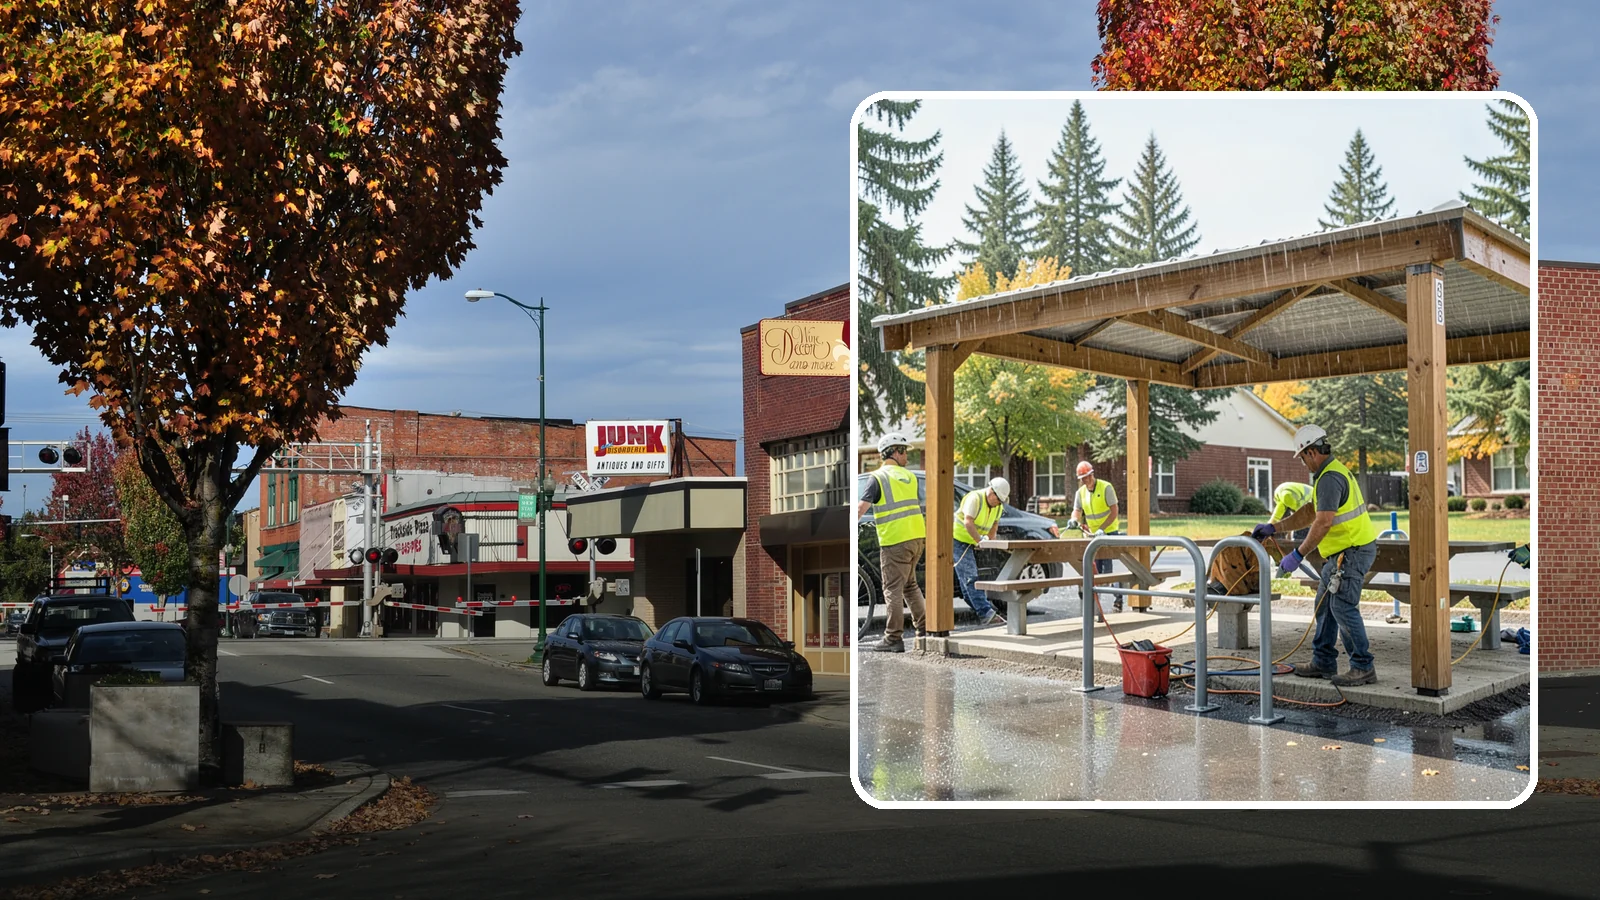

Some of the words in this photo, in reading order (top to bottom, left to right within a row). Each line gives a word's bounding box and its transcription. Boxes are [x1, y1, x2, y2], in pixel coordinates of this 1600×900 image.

[595, 425, 664, 457] JUNK
[607, 446, 646, 454] DISORDERLY
[597, 461, 628, 470] ANTIQUES
[631, 461, 644, 470] AND
[647, 460, 665, 469] GIFTS
